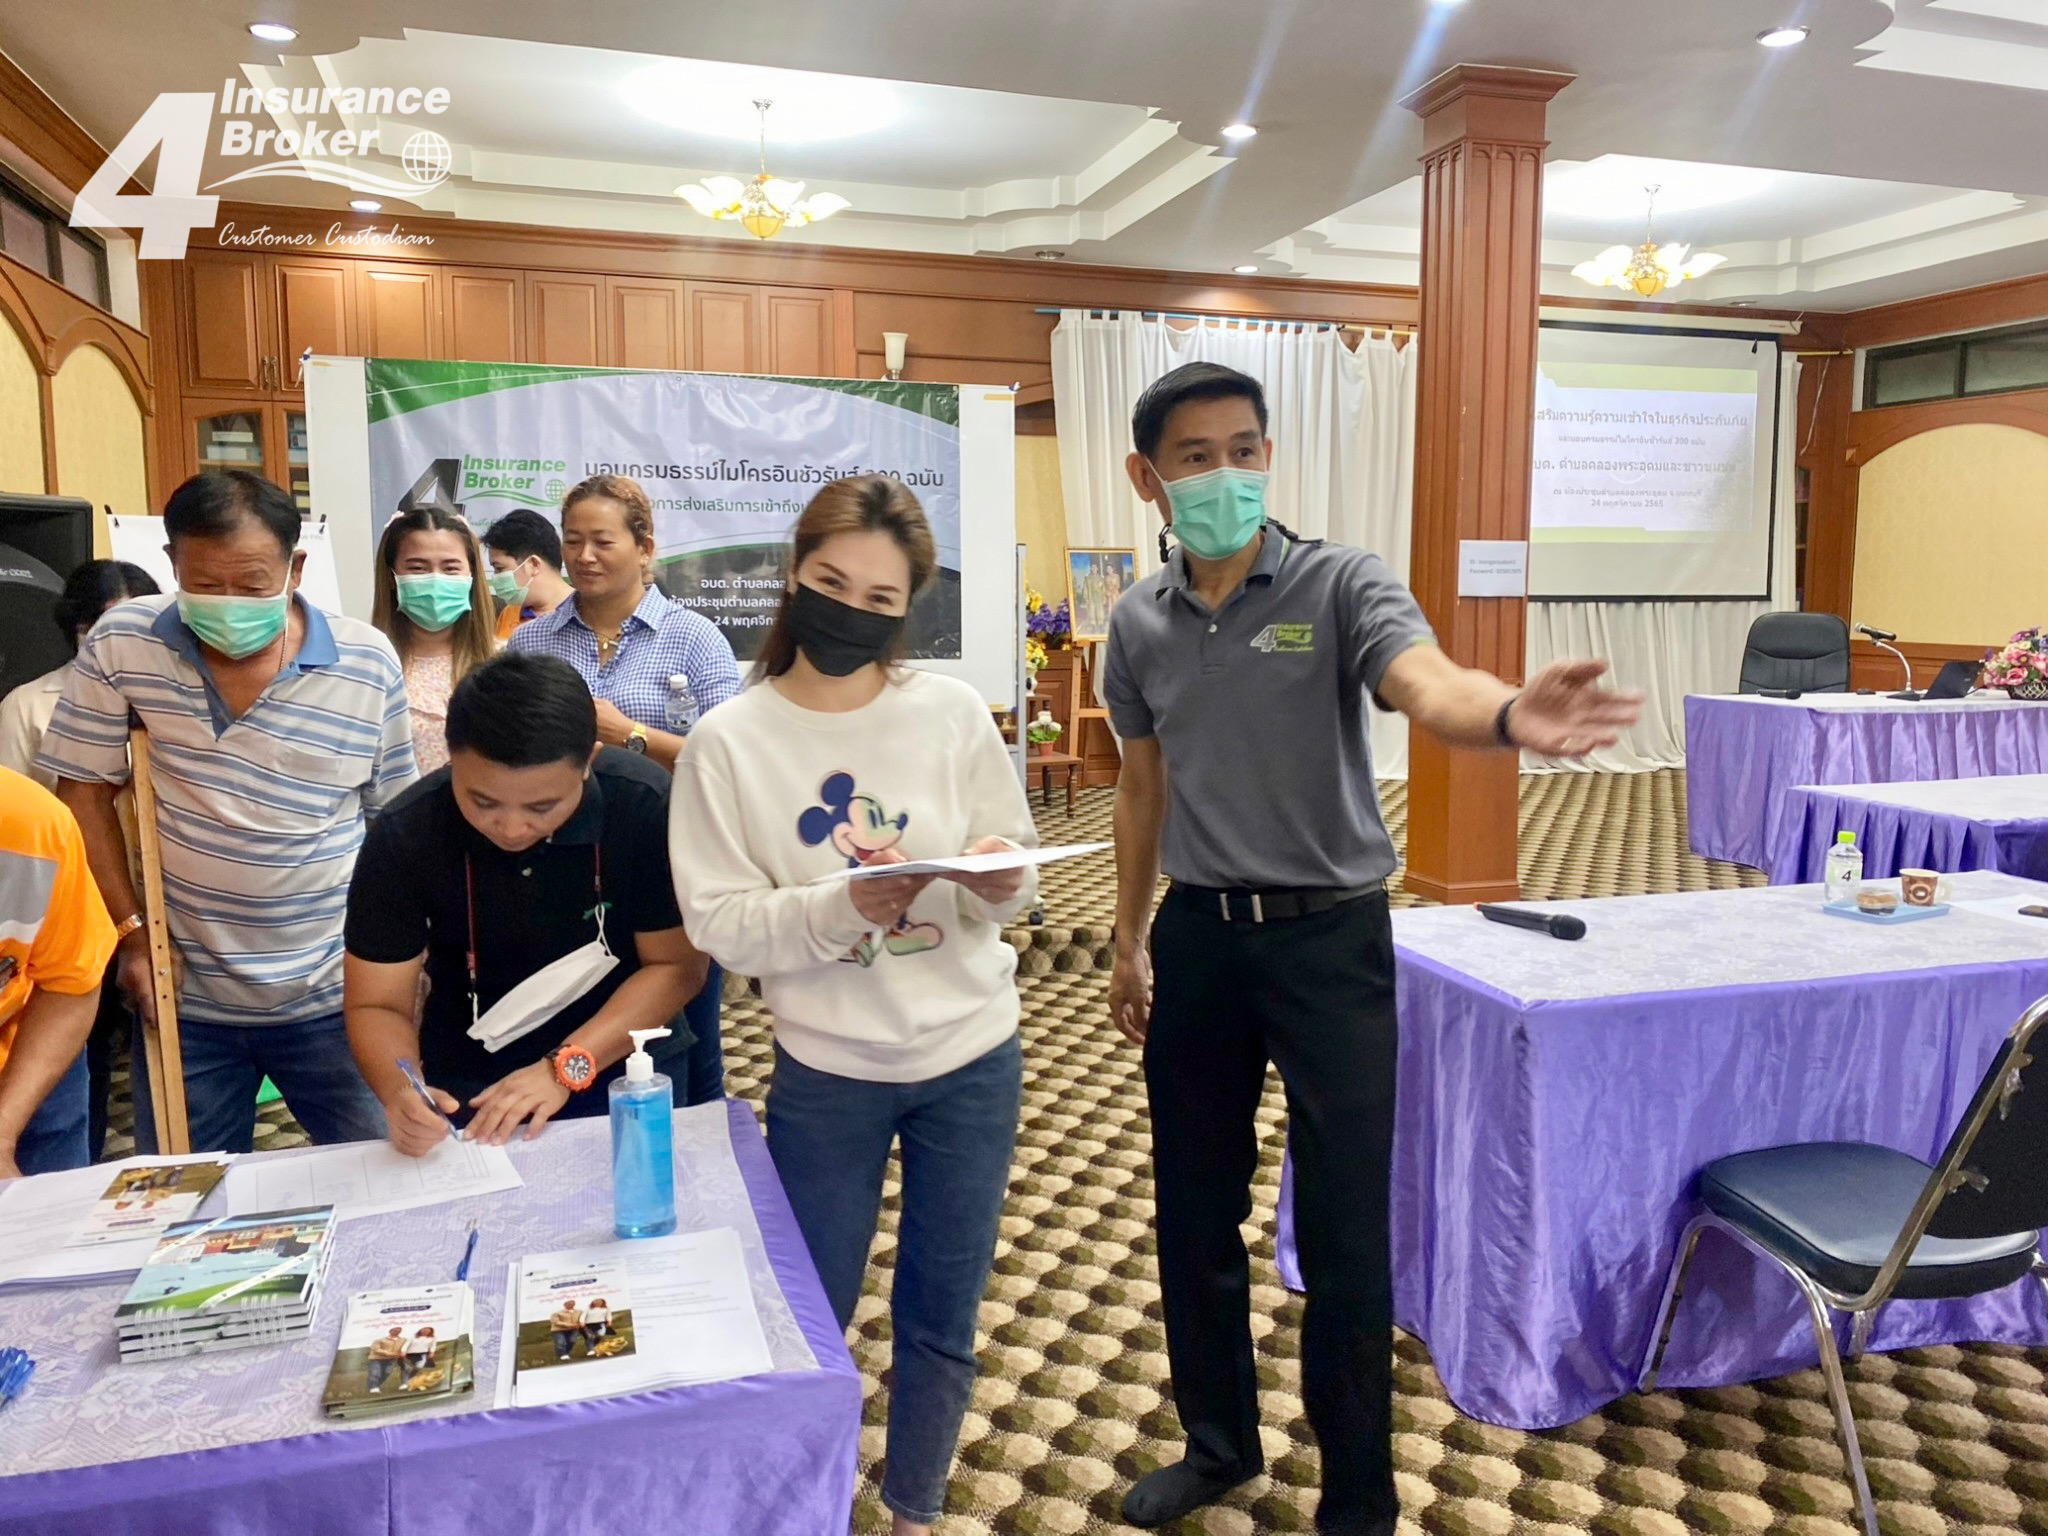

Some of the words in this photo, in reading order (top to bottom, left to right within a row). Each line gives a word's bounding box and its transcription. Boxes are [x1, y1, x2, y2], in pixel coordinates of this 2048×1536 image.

[463, 454, 566, 472] Insurance
[463, 473, 535, 489] Broker
[701, 579, 730, 589] อบต.
[713, 615, 730, 626] 24
[731, 614, 777, 628] พฤศจิก
